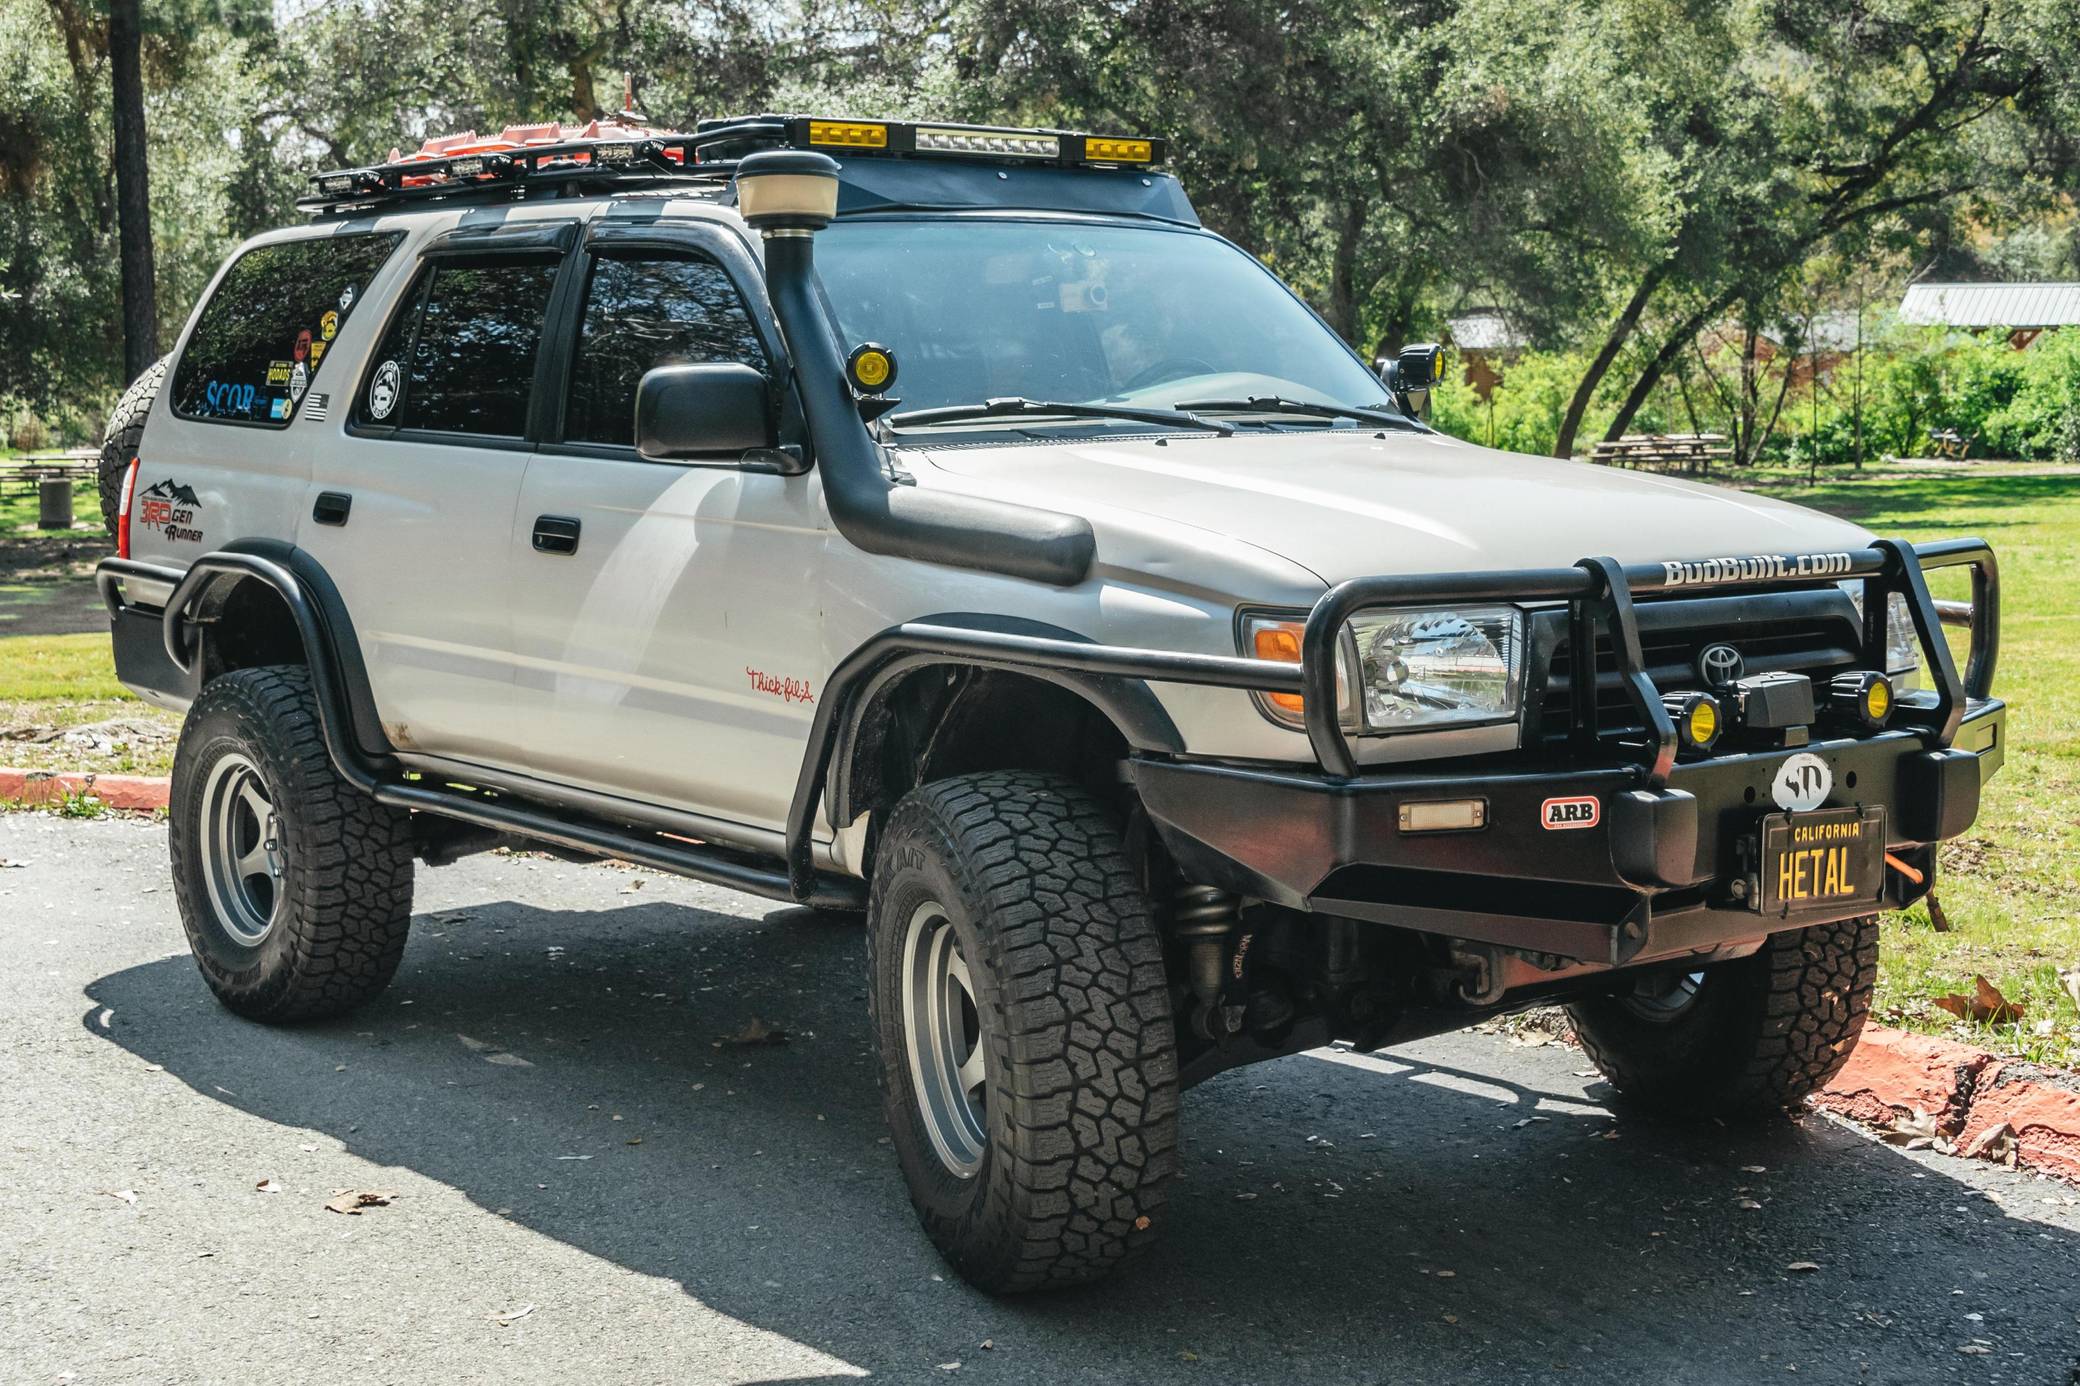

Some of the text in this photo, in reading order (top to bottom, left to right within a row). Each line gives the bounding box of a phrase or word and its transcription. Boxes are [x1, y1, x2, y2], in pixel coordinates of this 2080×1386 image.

[1661, 552, 1851, 586] BudBuilt.com
[1549, 803, 1593, 823] ARB
[1794, 822, 1860, 843] CALIFORNIA
[1778, 847, 1855, 901] HETAL
